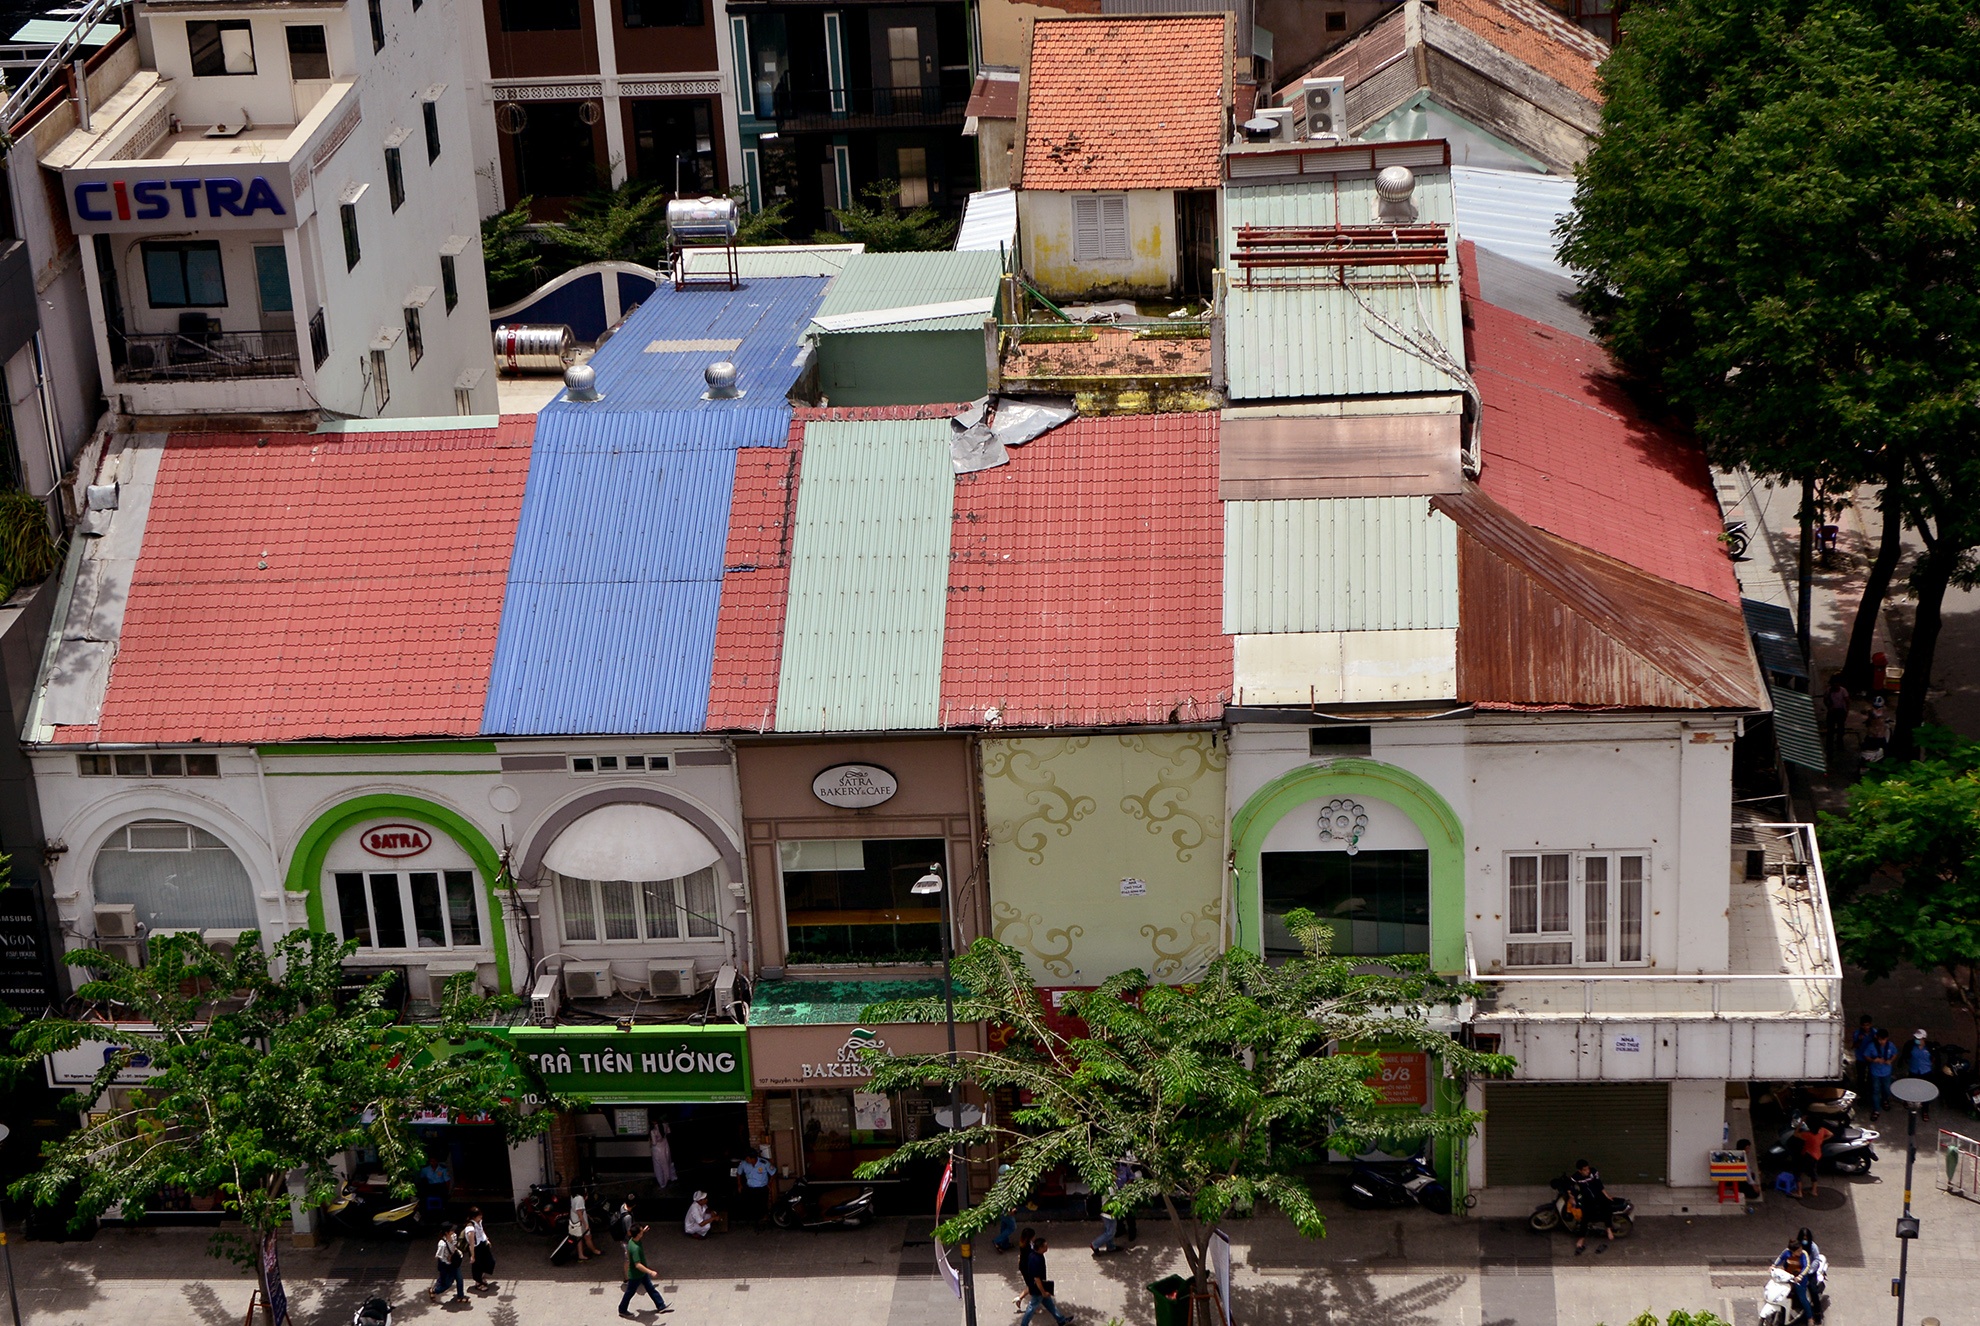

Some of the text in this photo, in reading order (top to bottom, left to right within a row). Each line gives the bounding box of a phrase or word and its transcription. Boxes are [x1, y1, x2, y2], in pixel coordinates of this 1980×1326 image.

[839, 778, 873, 787] SATRA
[820, 787, 861, 796] BAKERY
[866, 786, 891, 795] CAFE
[371, 833, 423, 849] SATRA
[579, 1047, 633, 1073] TIÊN
[641, 1044, 736, 1073] HƯỞNG
[802, 1063, 874, 1078] BAKERY
[1382, 1067, 1410, 1081] 8/8
